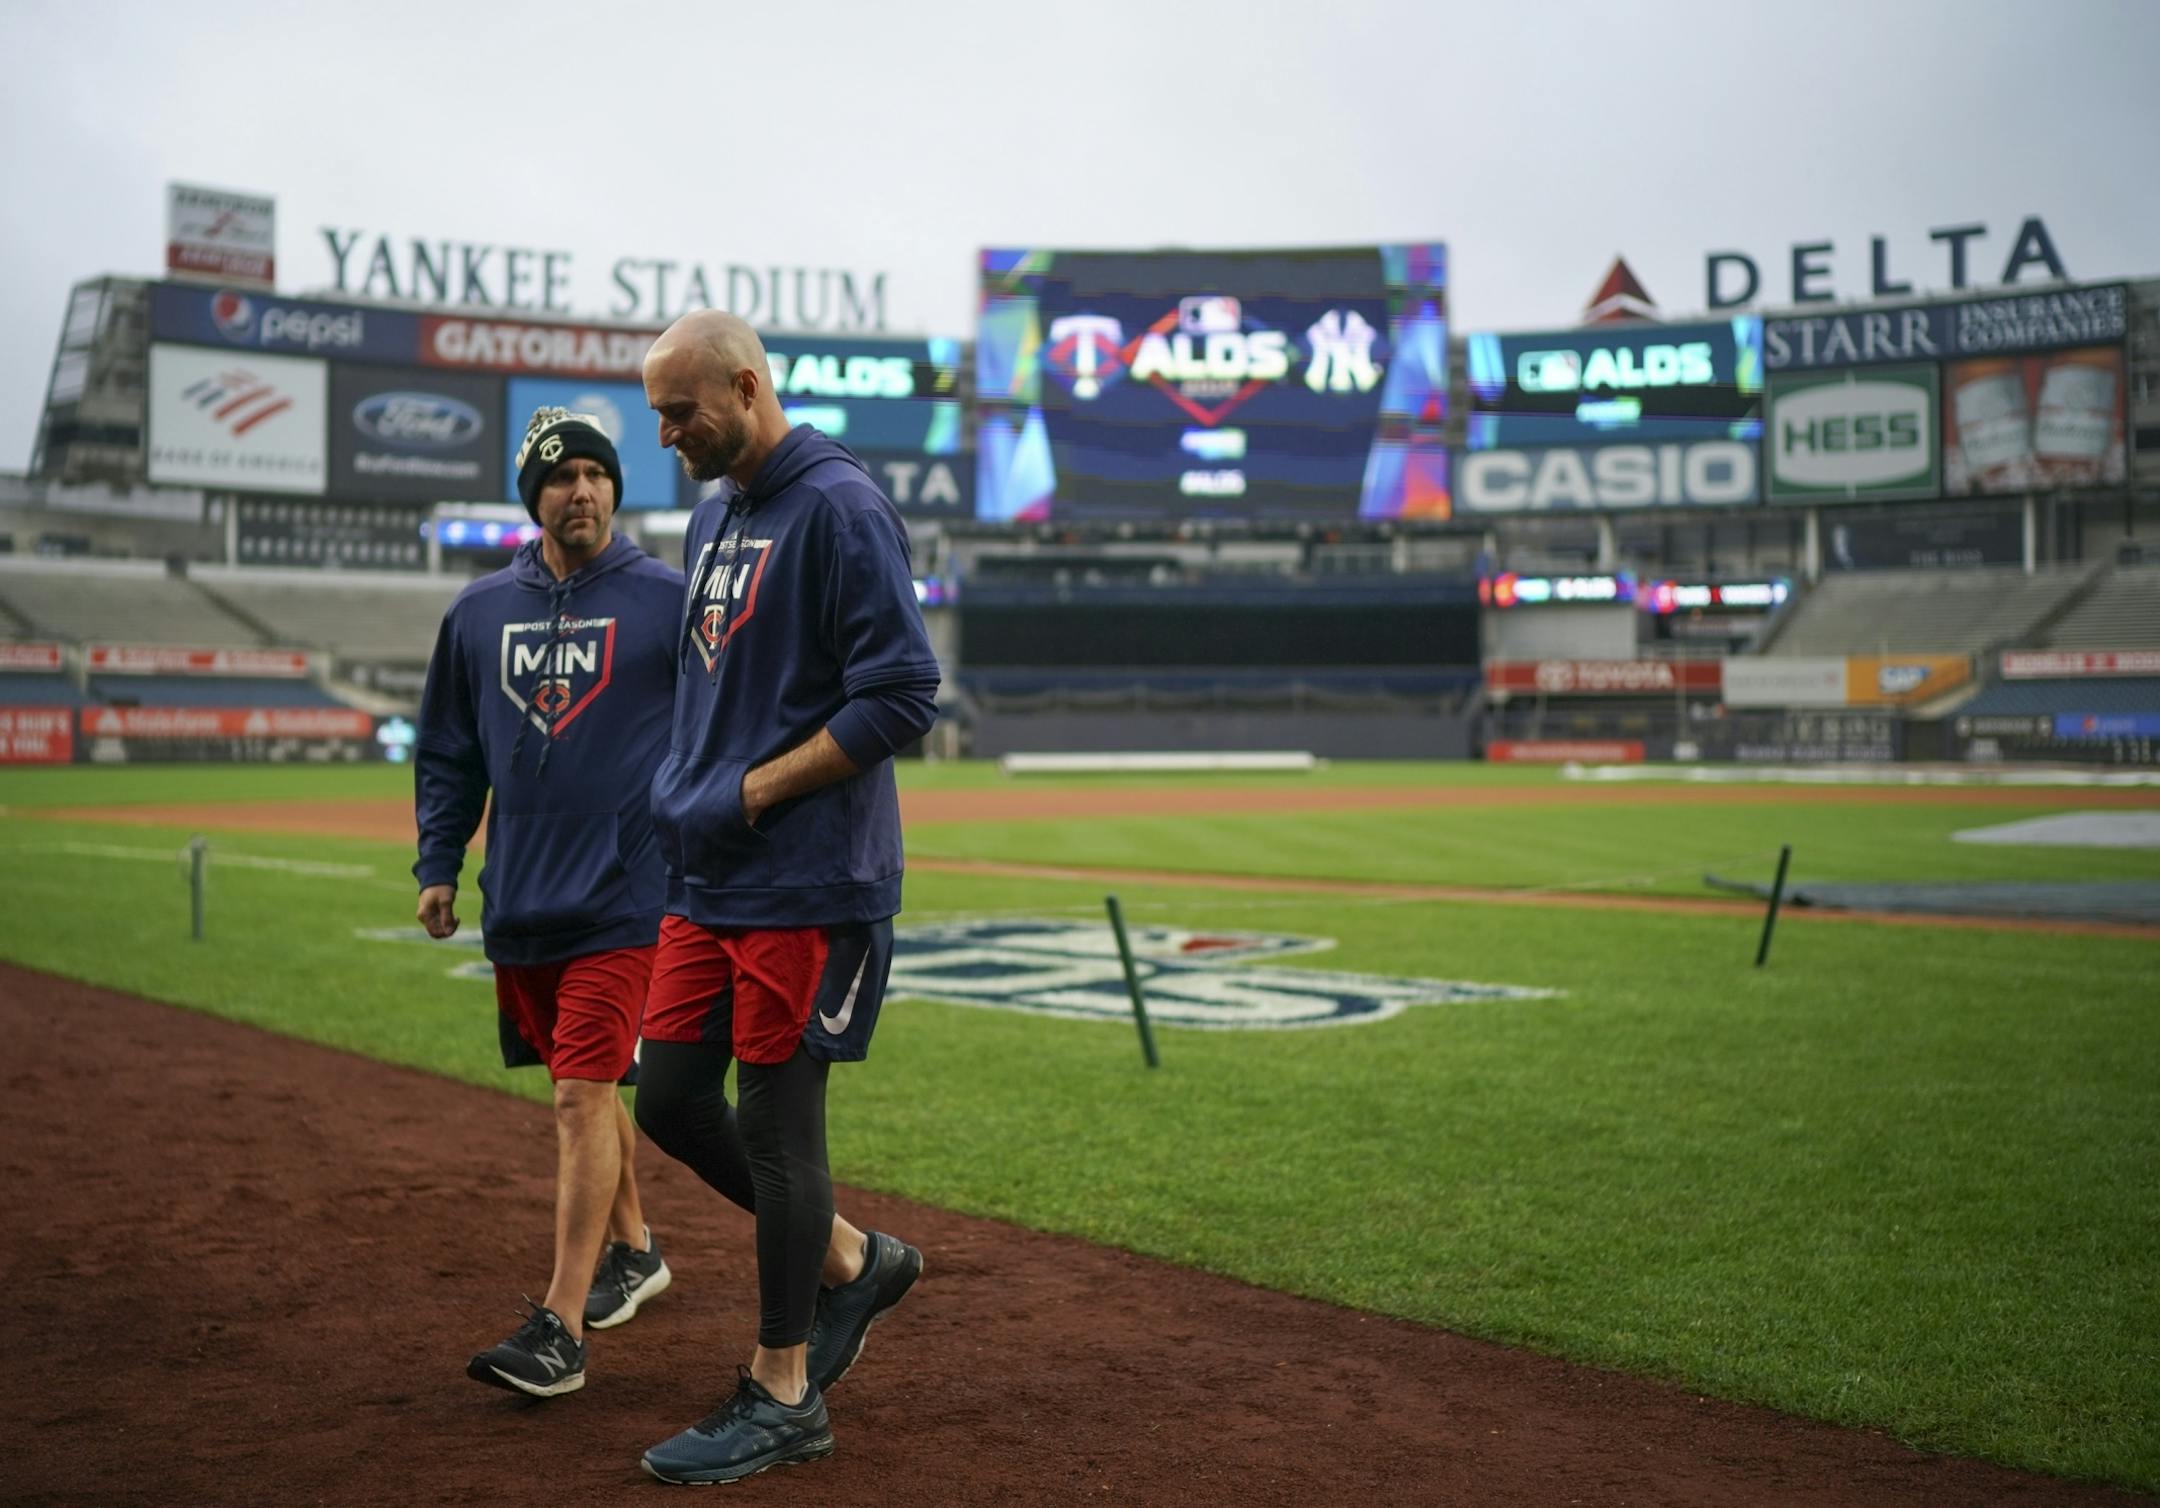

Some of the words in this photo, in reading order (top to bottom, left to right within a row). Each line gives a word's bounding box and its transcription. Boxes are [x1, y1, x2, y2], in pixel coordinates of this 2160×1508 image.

[320, 227, 573, 315] YANKEE
[609, 256, 888, 330] STADIUM
[1707, 215, 2068, 311] DELTA
[261, 305, 363, 348] pepsi
[1958, 285, 2124, 325] INSURANCE
[1766, 309, 1938, 369] STARR
[1958, 312, 2126, 352] COMPANIES
[787, 354, 915, 398] ALDS
[1131, 331, 1288, 380] ALDS
[1582, 343, 1712, 388] ALDS
[1784, 412, 1919, 457] HESS
[1461, 439, 1755, 512] CASIO
[524, 619, 593, 632] POSTEASON
[514, 640, 597, 676] MIN
[1577, 661, 1674, 689] TOYOTA
